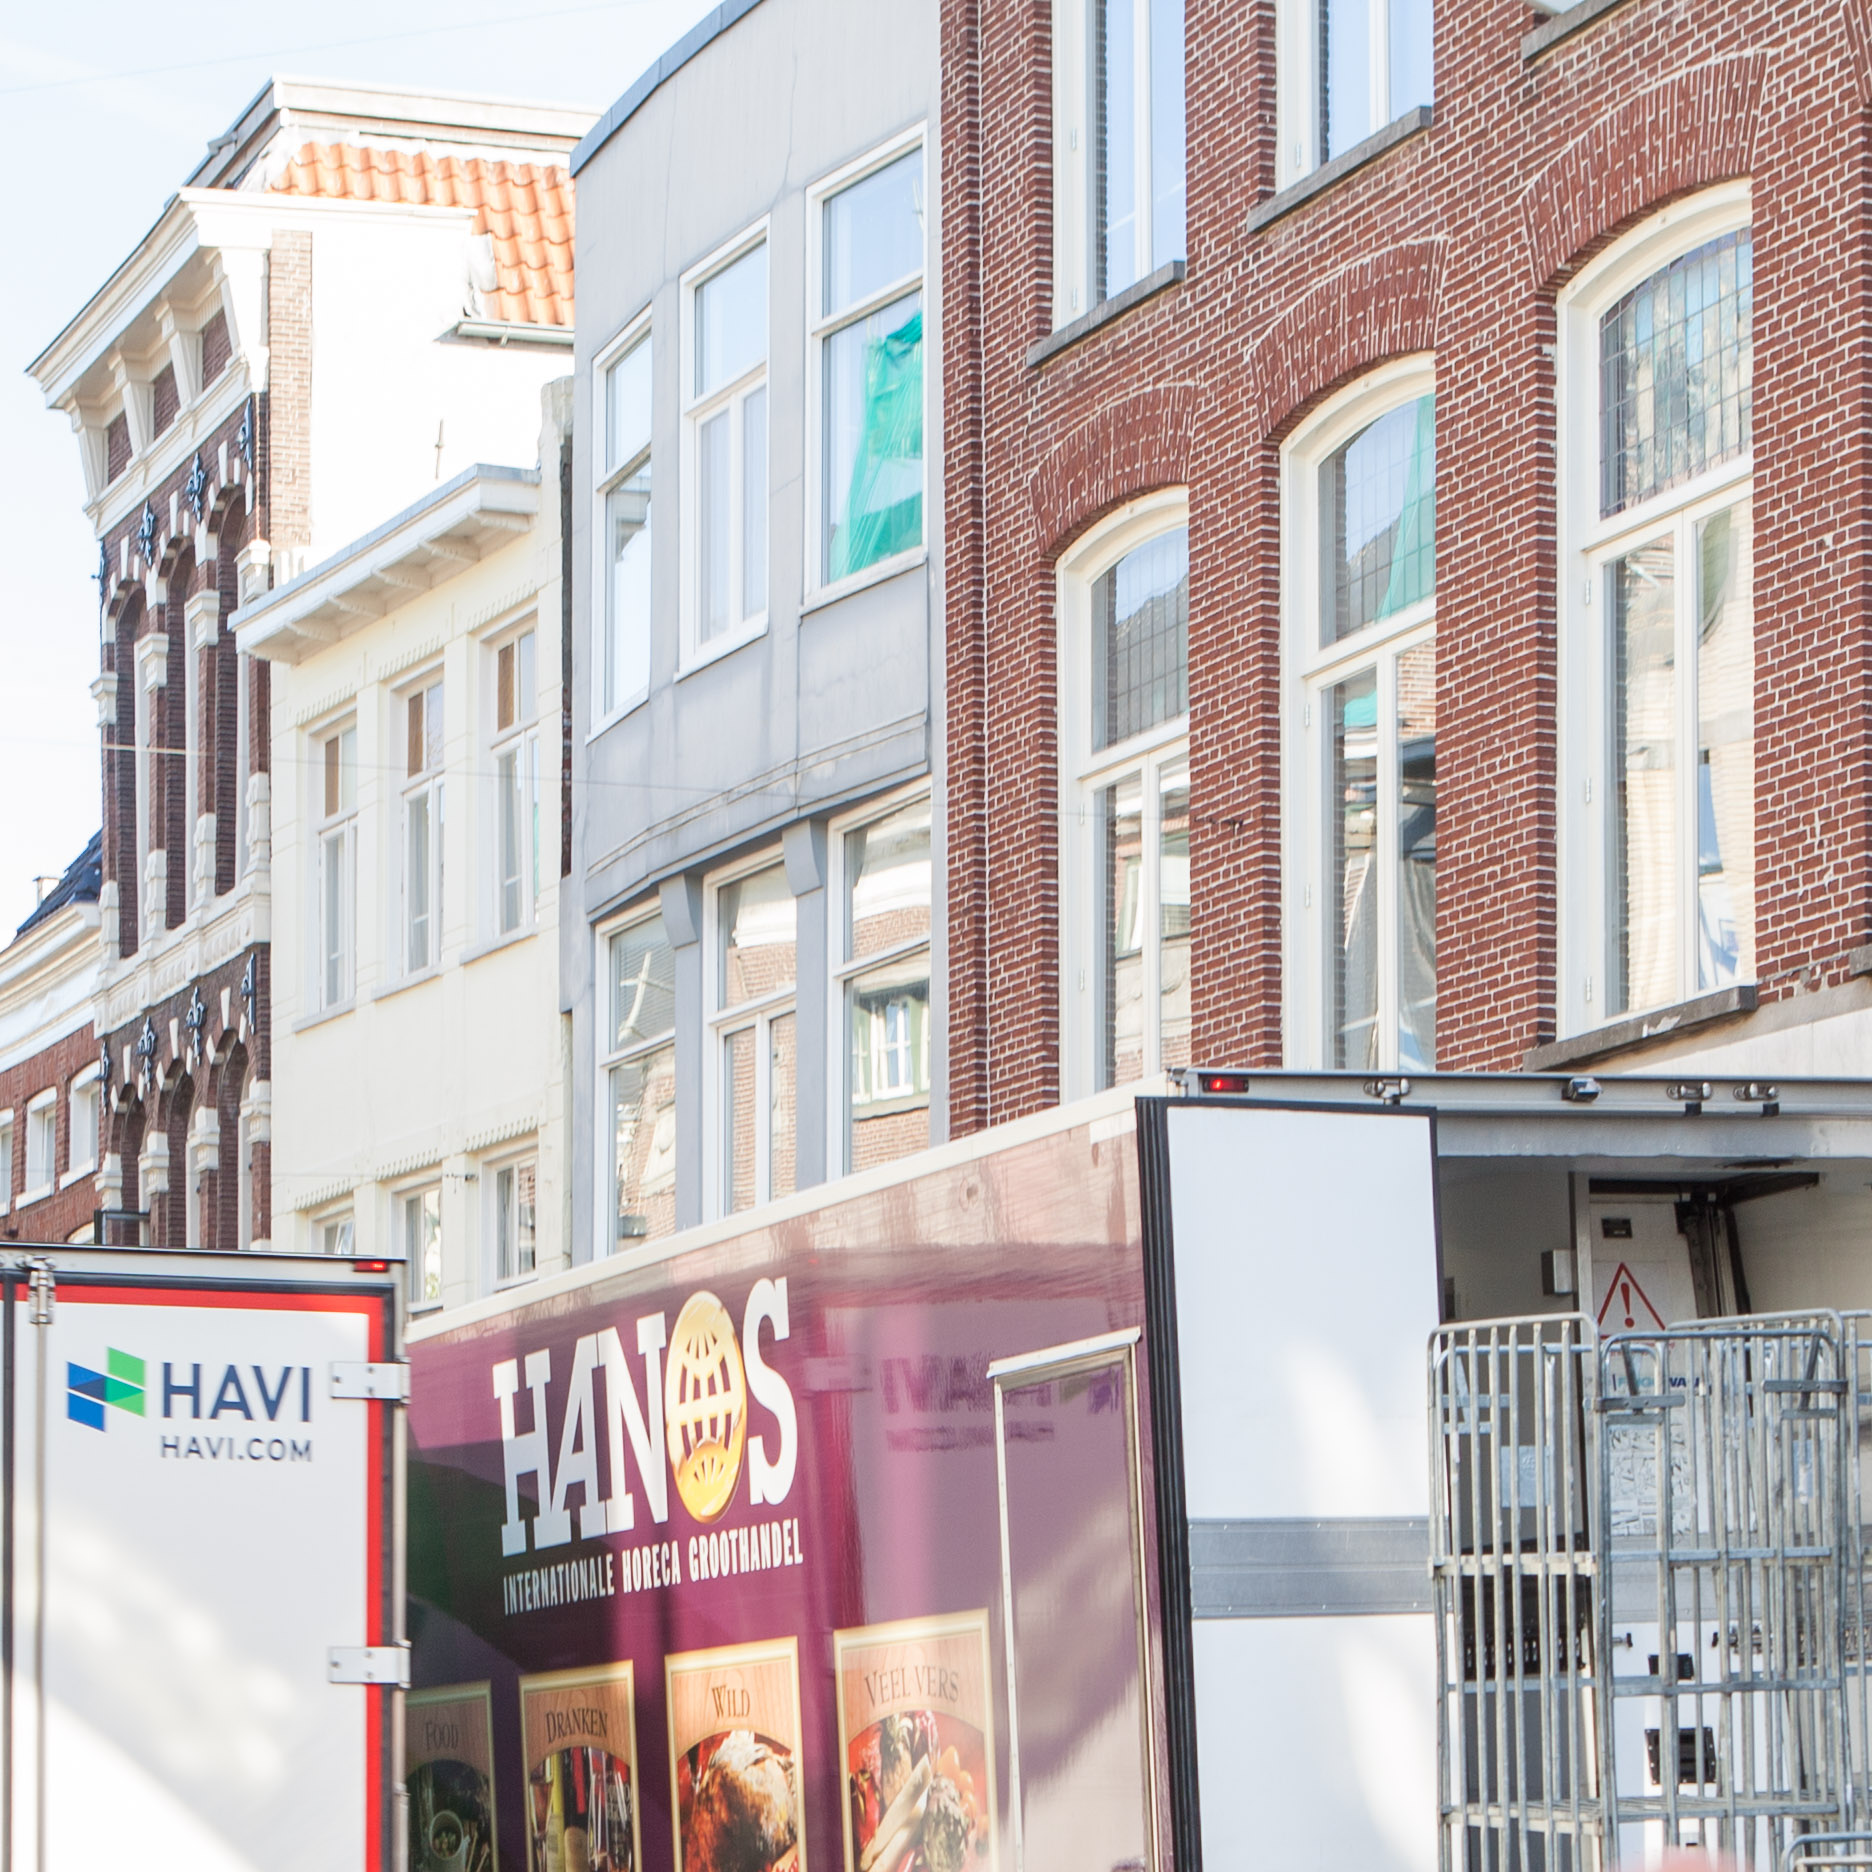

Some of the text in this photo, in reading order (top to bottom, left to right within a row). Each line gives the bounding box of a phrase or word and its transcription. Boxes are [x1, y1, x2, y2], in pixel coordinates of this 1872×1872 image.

[162, 1361, 311, 1422] HAVI
[492, 1276, 798, 1557] HANOS
[161, 1435, 312, 1462] HAVI.COM
[502, 1518, 804, 1616] INTERNATIONALE HORECA GROOTHANDEL
[711, 1683, 751, 1719] WILD
[863, 1669, 960, 1708] VEEL VERS
[546, 1707, 609, 1744] DRANKEN
